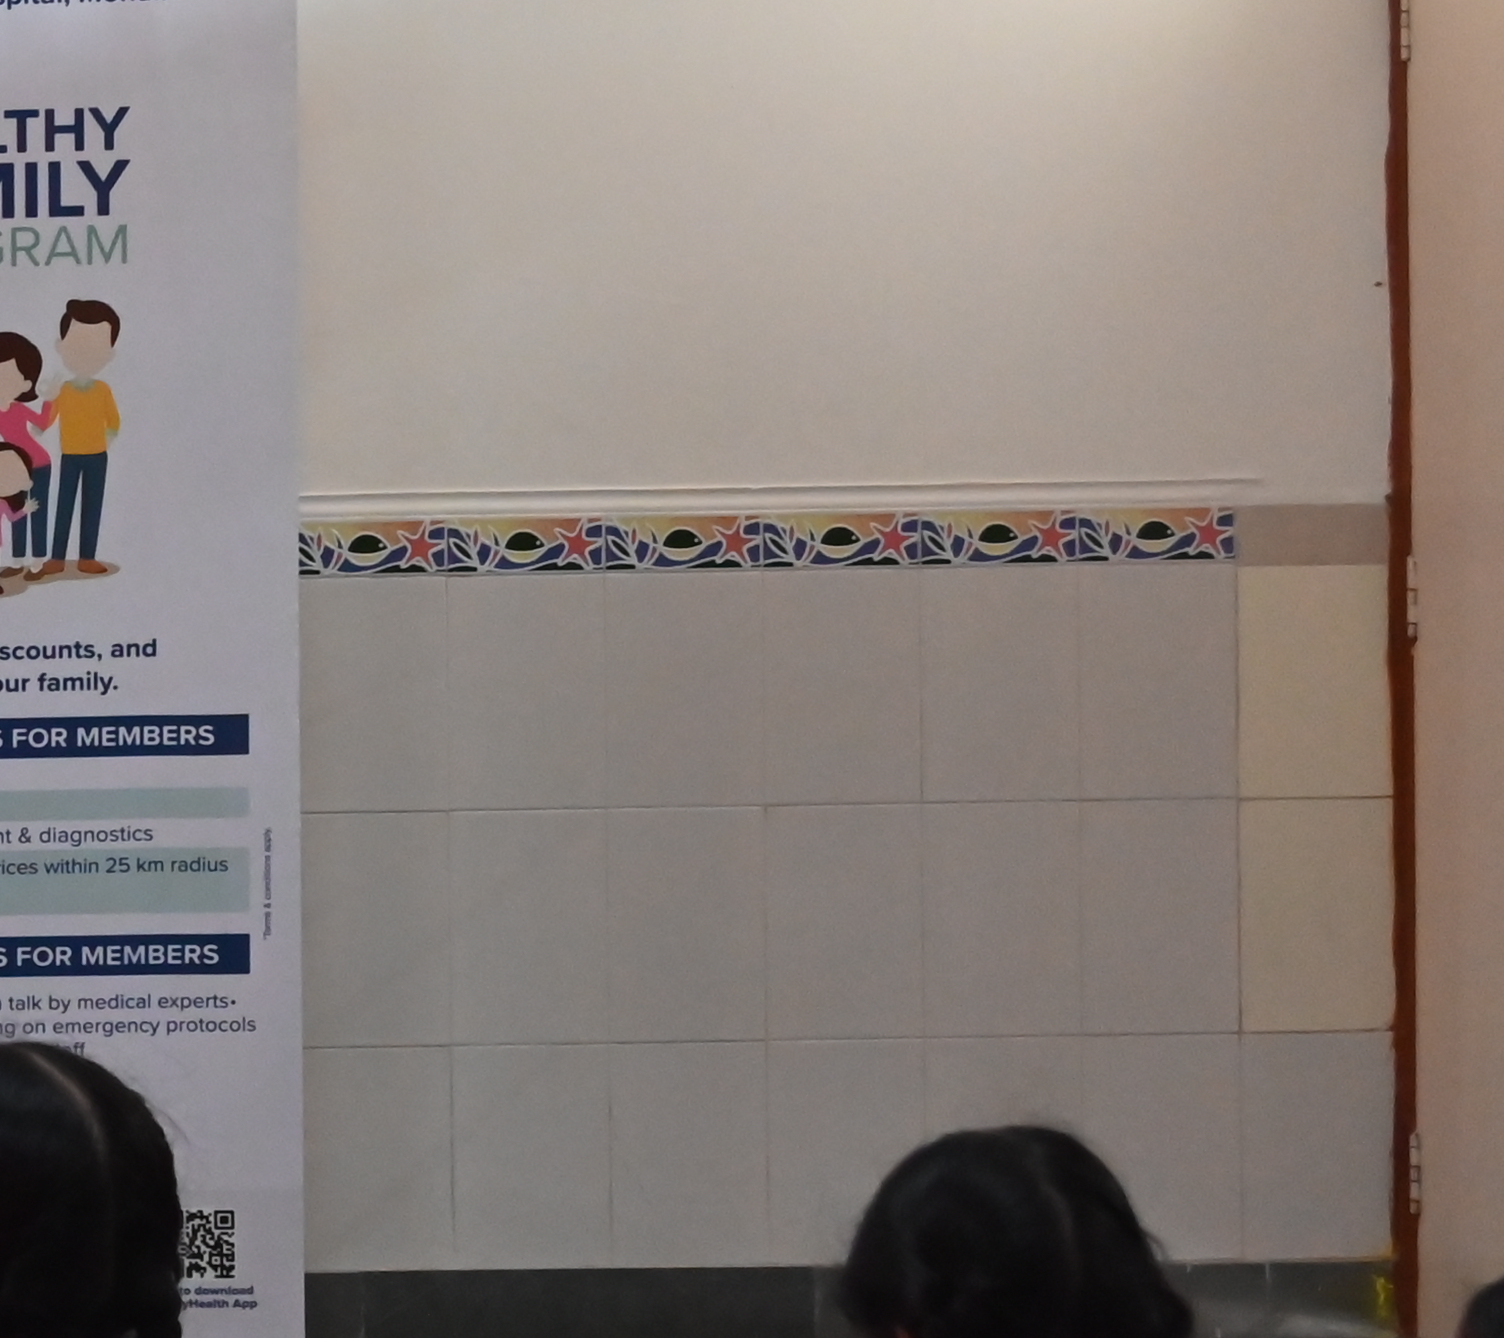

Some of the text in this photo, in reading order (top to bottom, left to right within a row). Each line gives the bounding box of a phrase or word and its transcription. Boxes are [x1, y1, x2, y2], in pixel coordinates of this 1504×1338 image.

[110, 637, 157, 659] and
[37, 670, 119, 696] family.
[12, 727, 68, 749] FOR
[76, 724, 215, 748] MEMBERS
[17, 826, 32, 844] &
[38, 825, 154, 848] diagnostics
[43, 857, 100, 875] within
[105, 856, 131, 875] 25
[136, 856, 165, 873] km
[170, 855, 229, 873] radius
[16, 945, 73, 967] FOR
[81, 944, 220, 966] MEMBERS
[7, 995, 42, 1012] talk
[48, 994, 72, 1014] by
[77, 993, 152, 1011] medical
[157, 993, 229, 1012] experts
[22, 1021, 46, 1035] on
[52, 1019, 161, 1038] emergency
[166, 1016, 257, 1036] protocols
